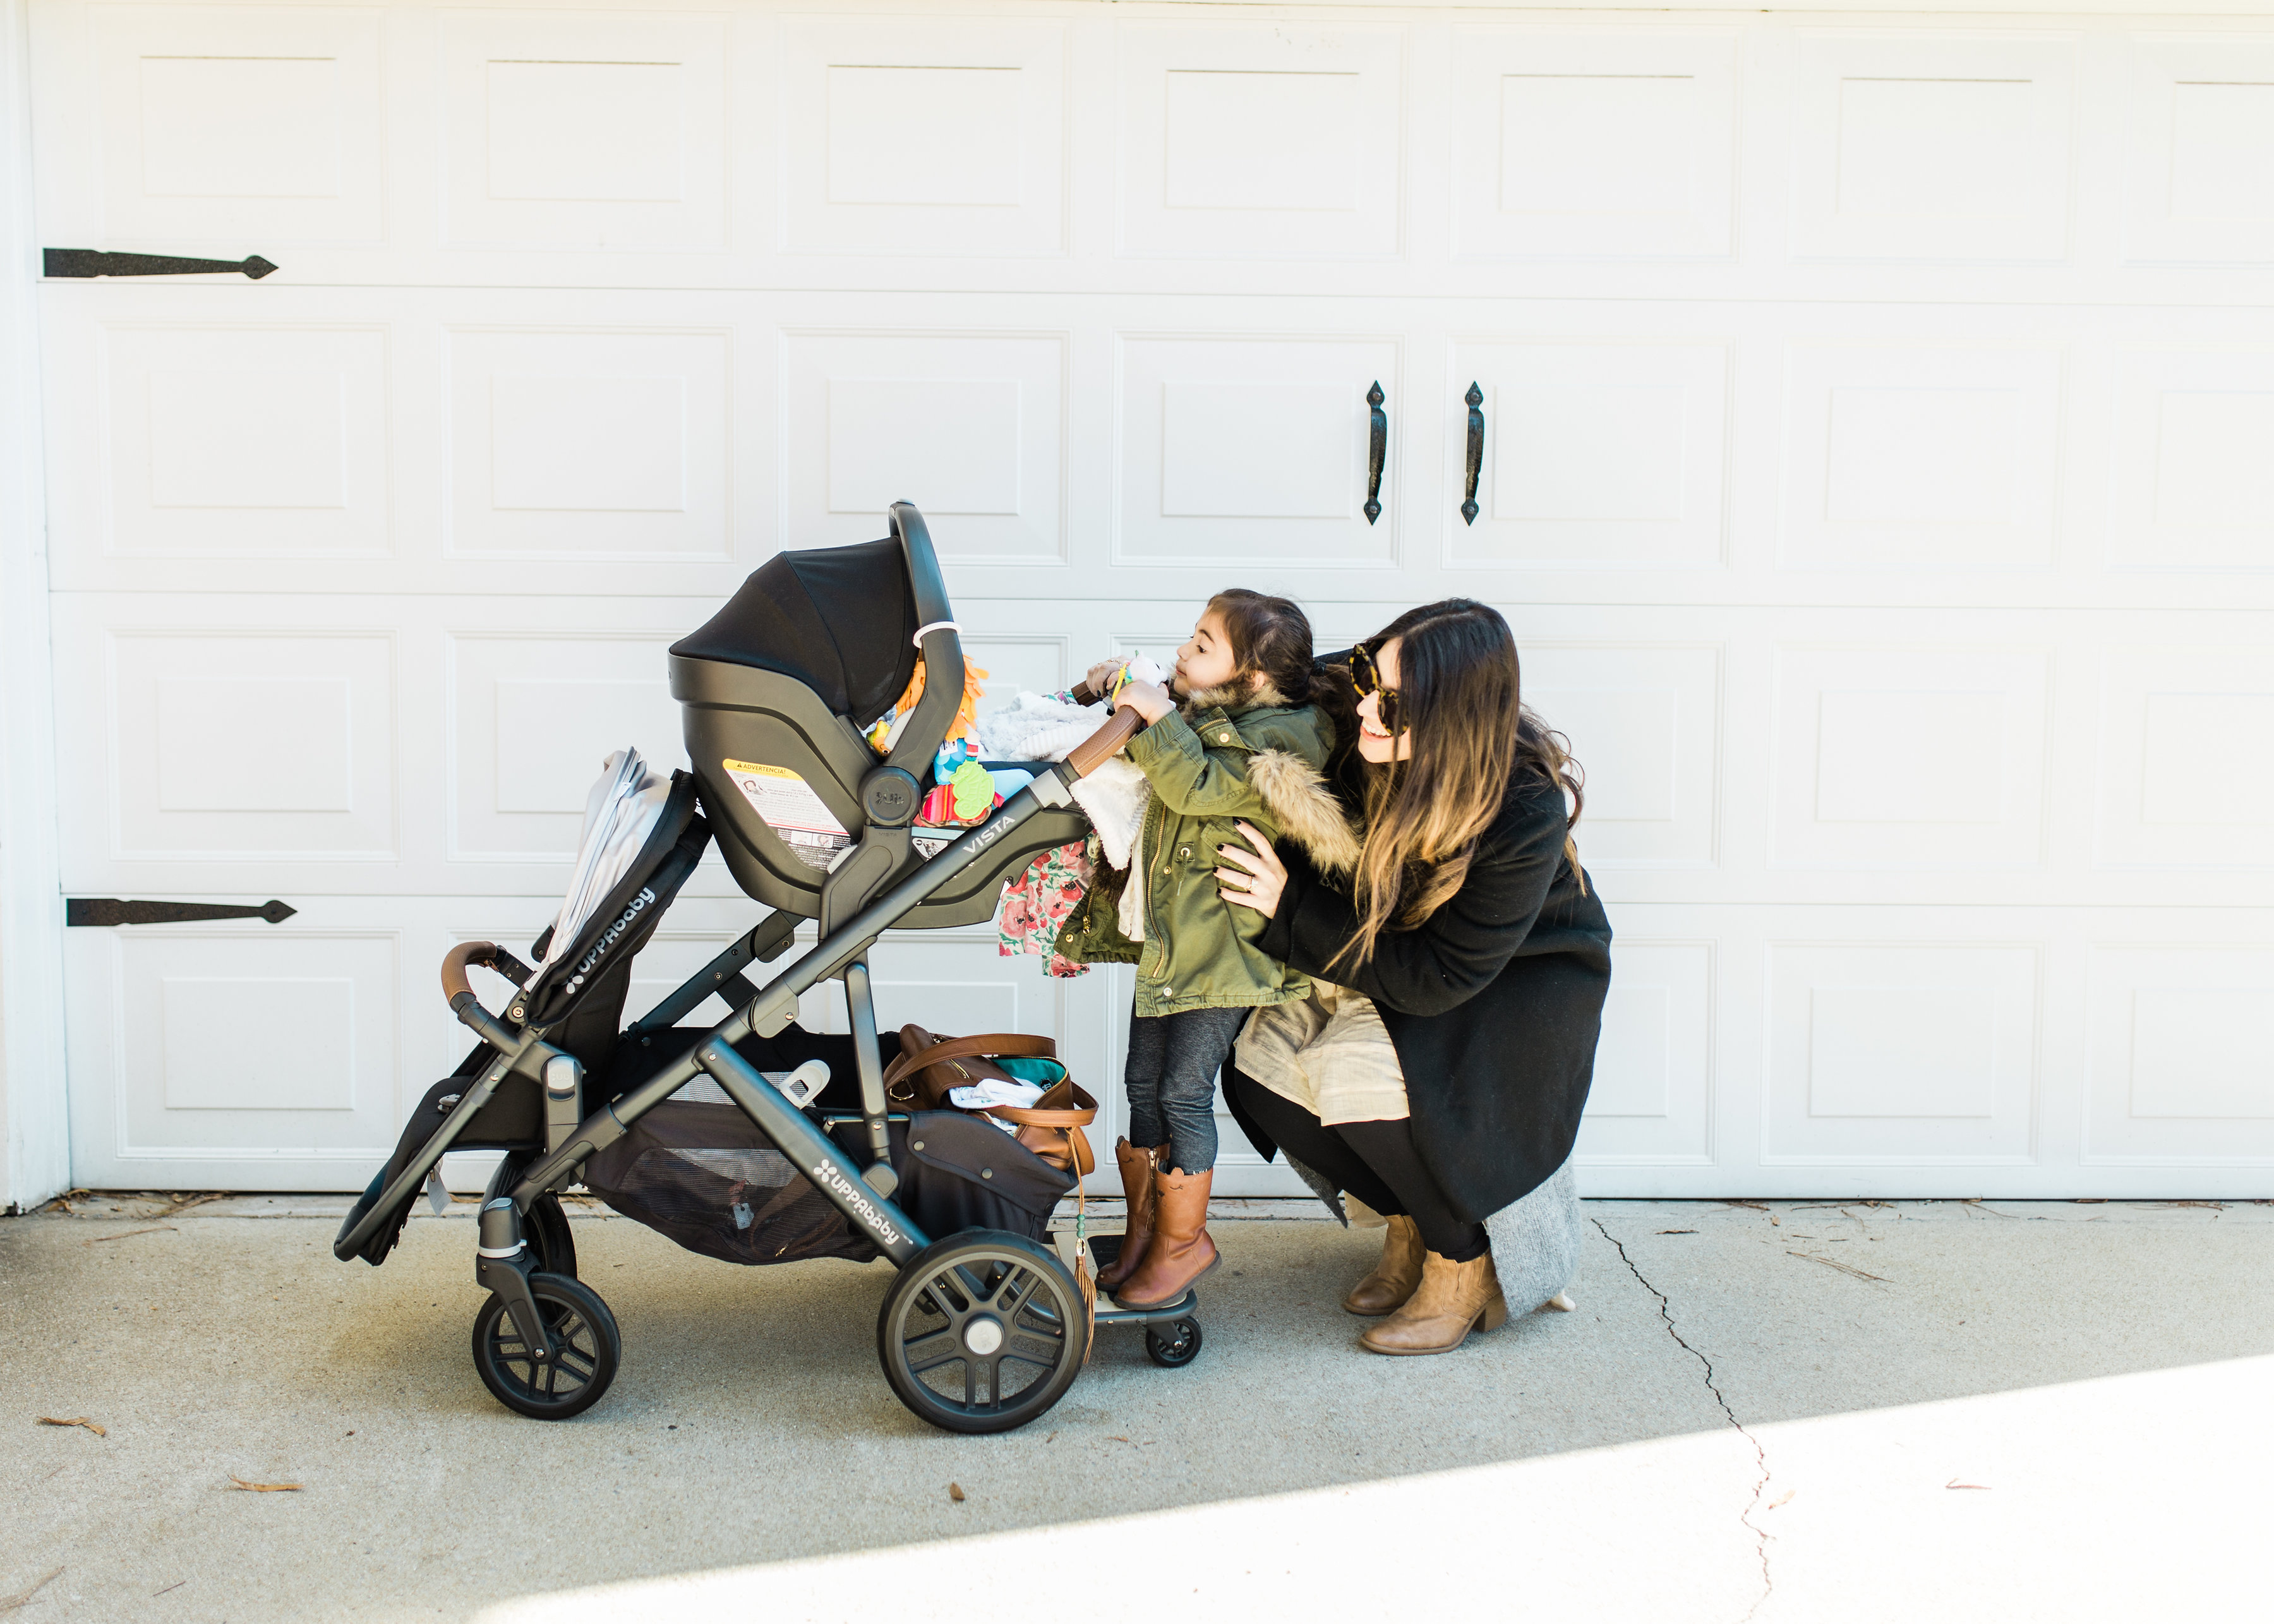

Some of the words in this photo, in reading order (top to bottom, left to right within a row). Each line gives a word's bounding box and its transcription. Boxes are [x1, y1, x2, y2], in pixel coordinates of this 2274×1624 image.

[743, 763, 786, 774] ADVERTENCIA!
[963, 815, 1016, 853] VISTA
[577, 887, 656, 973] UPPAbaby
[831, 1174, 899, 1245] UPPAbaby
